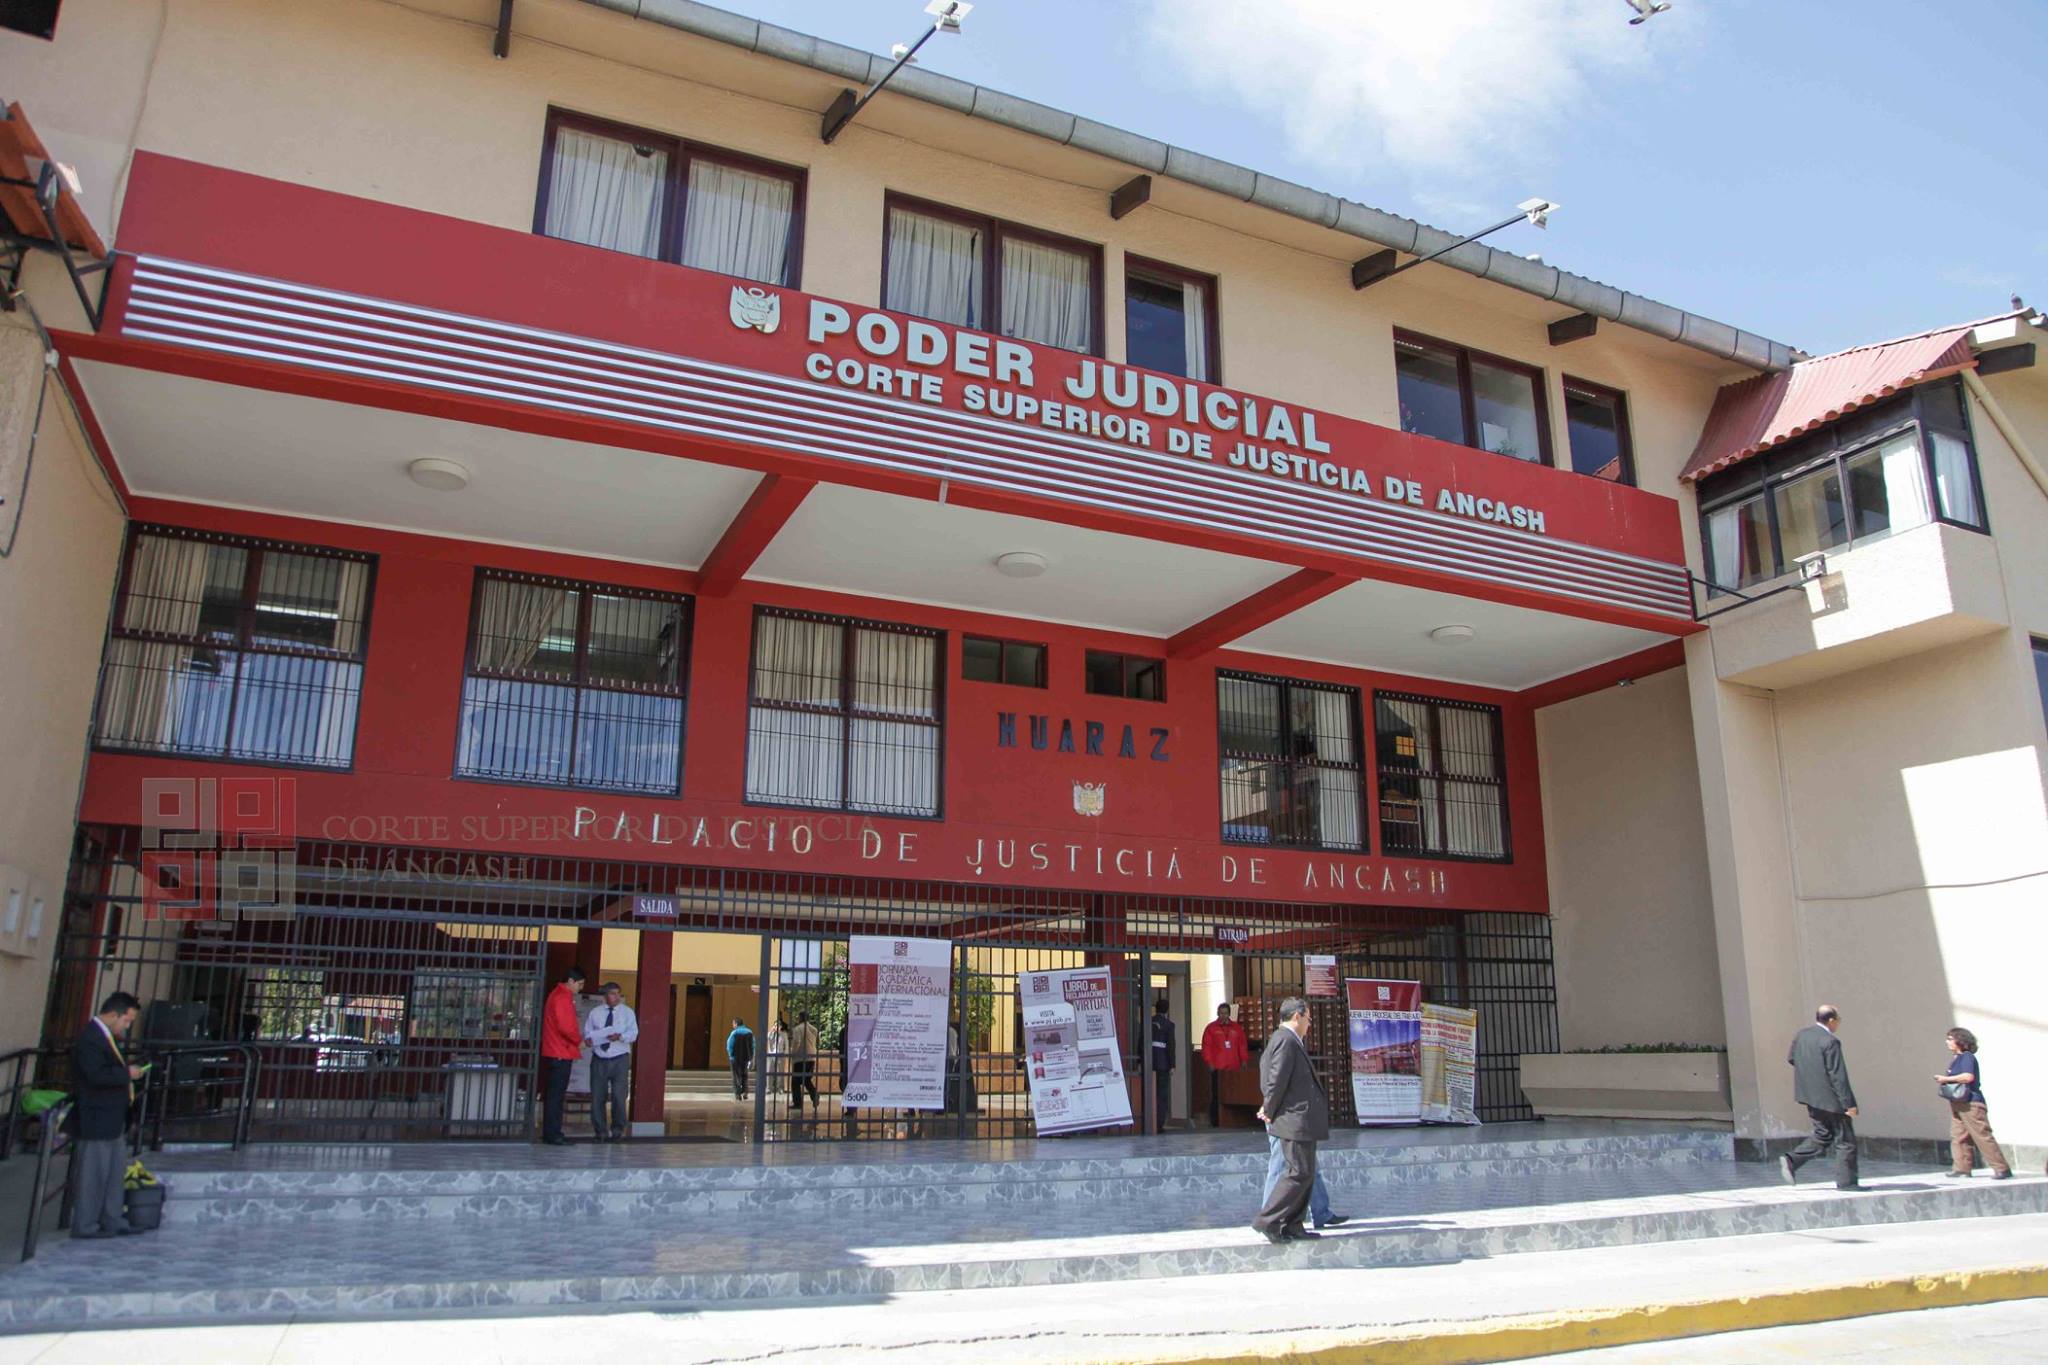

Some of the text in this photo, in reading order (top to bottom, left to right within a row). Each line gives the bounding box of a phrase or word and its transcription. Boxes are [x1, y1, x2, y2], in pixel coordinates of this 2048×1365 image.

[808, 299, 1331, 454] PODER JUDICIAL
[806, 353, 1546, 534] CORTE SUPERIOR DE JUSTICIA DE ANCASH
[997, 712, 1170, 762] HUARAZ
[573, 806, 812, 855] PALACIO
[861, 829, 919, 862] DE
[1221, 855, 1267, 885] DE
[1303, 862, 1446, 895] ANCASH
[639, 899, 674, 915] SALIDA
[1218, 927, 1249, 944] ENTRADA
[878, 985, 949, 998] INTERNACIONAL
[1064, 979, 1098, 993] LIBRO DE
[853, 1003, 873, 1016] 11
[1074, 997, 1109, 1012] VIRTUAL
